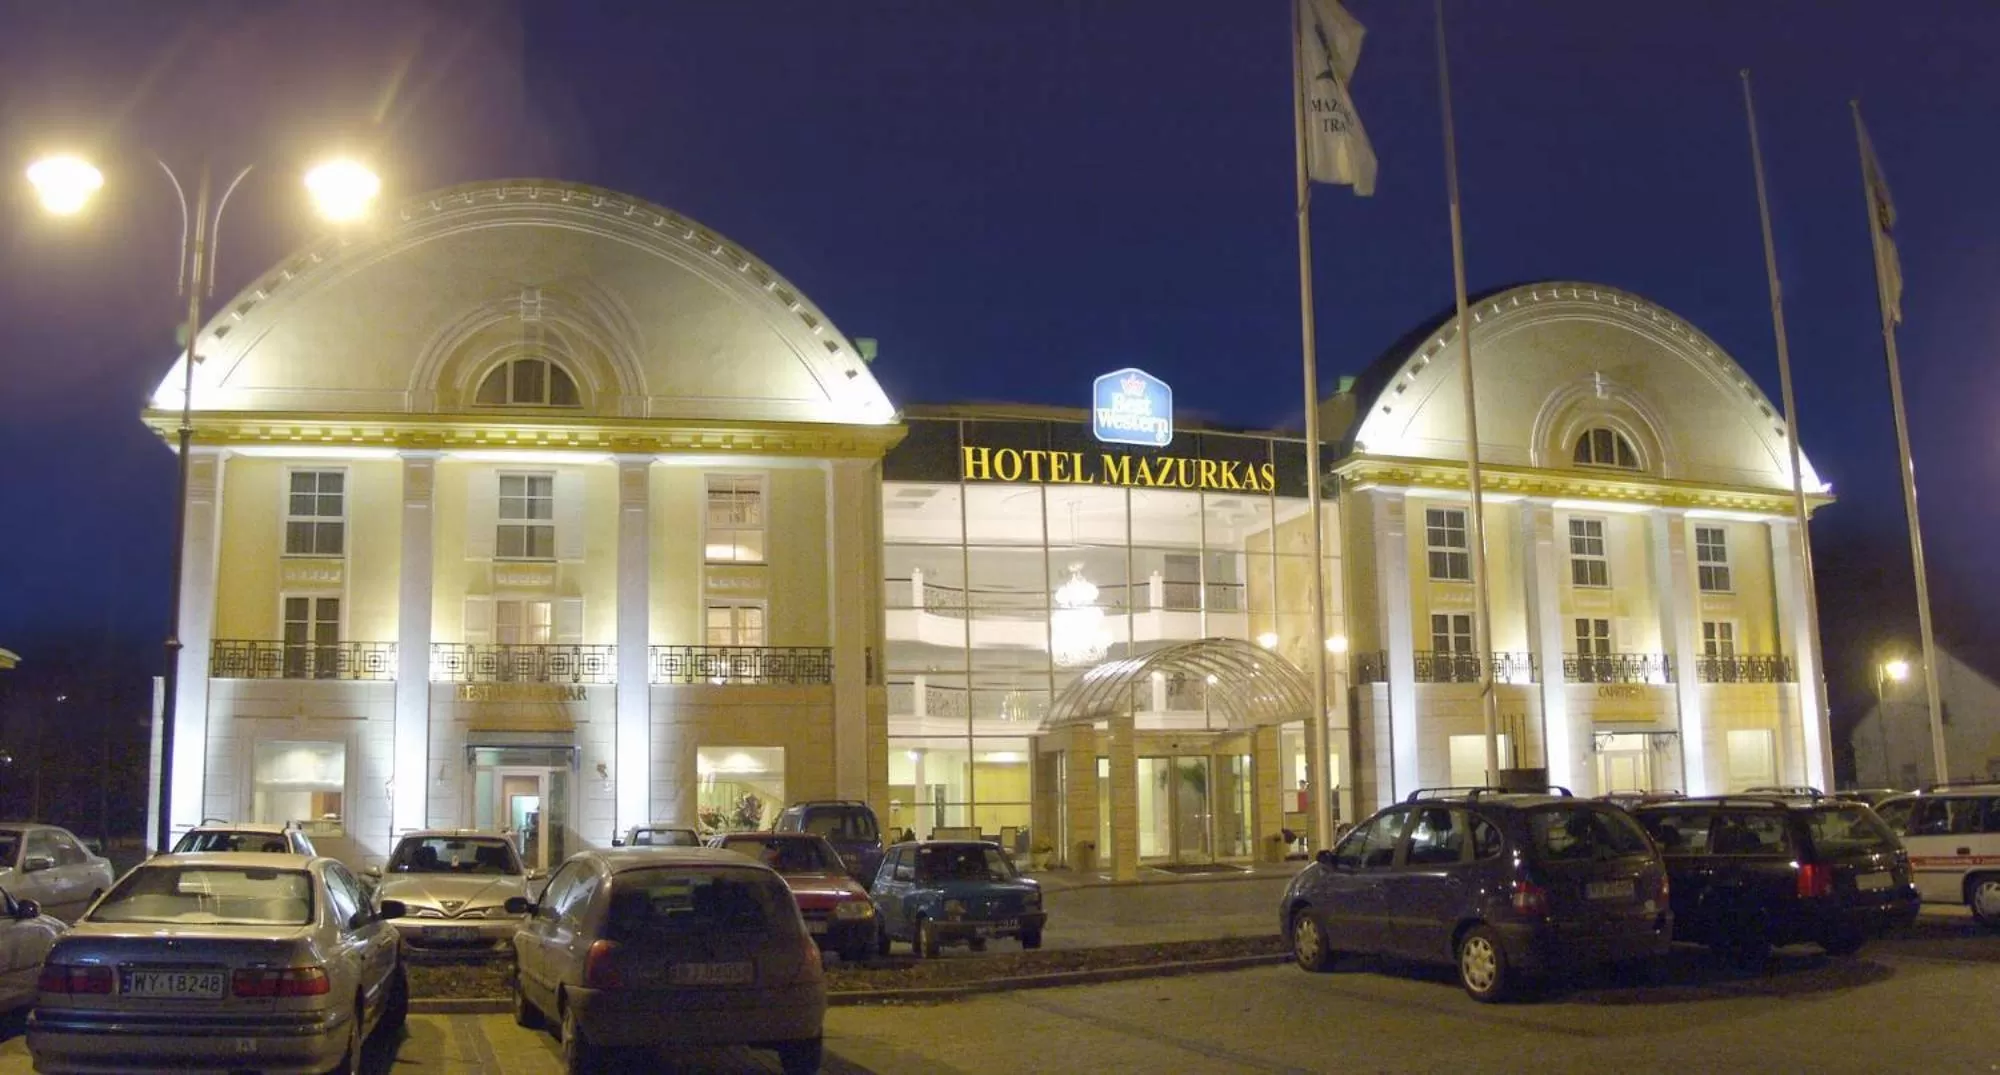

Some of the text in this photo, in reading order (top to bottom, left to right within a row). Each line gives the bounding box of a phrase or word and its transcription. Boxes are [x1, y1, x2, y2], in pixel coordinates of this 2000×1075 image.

[1096, 408, 1169, 434] Western
[962, 446, 1276, 491] HOTEL MAZURKAS
